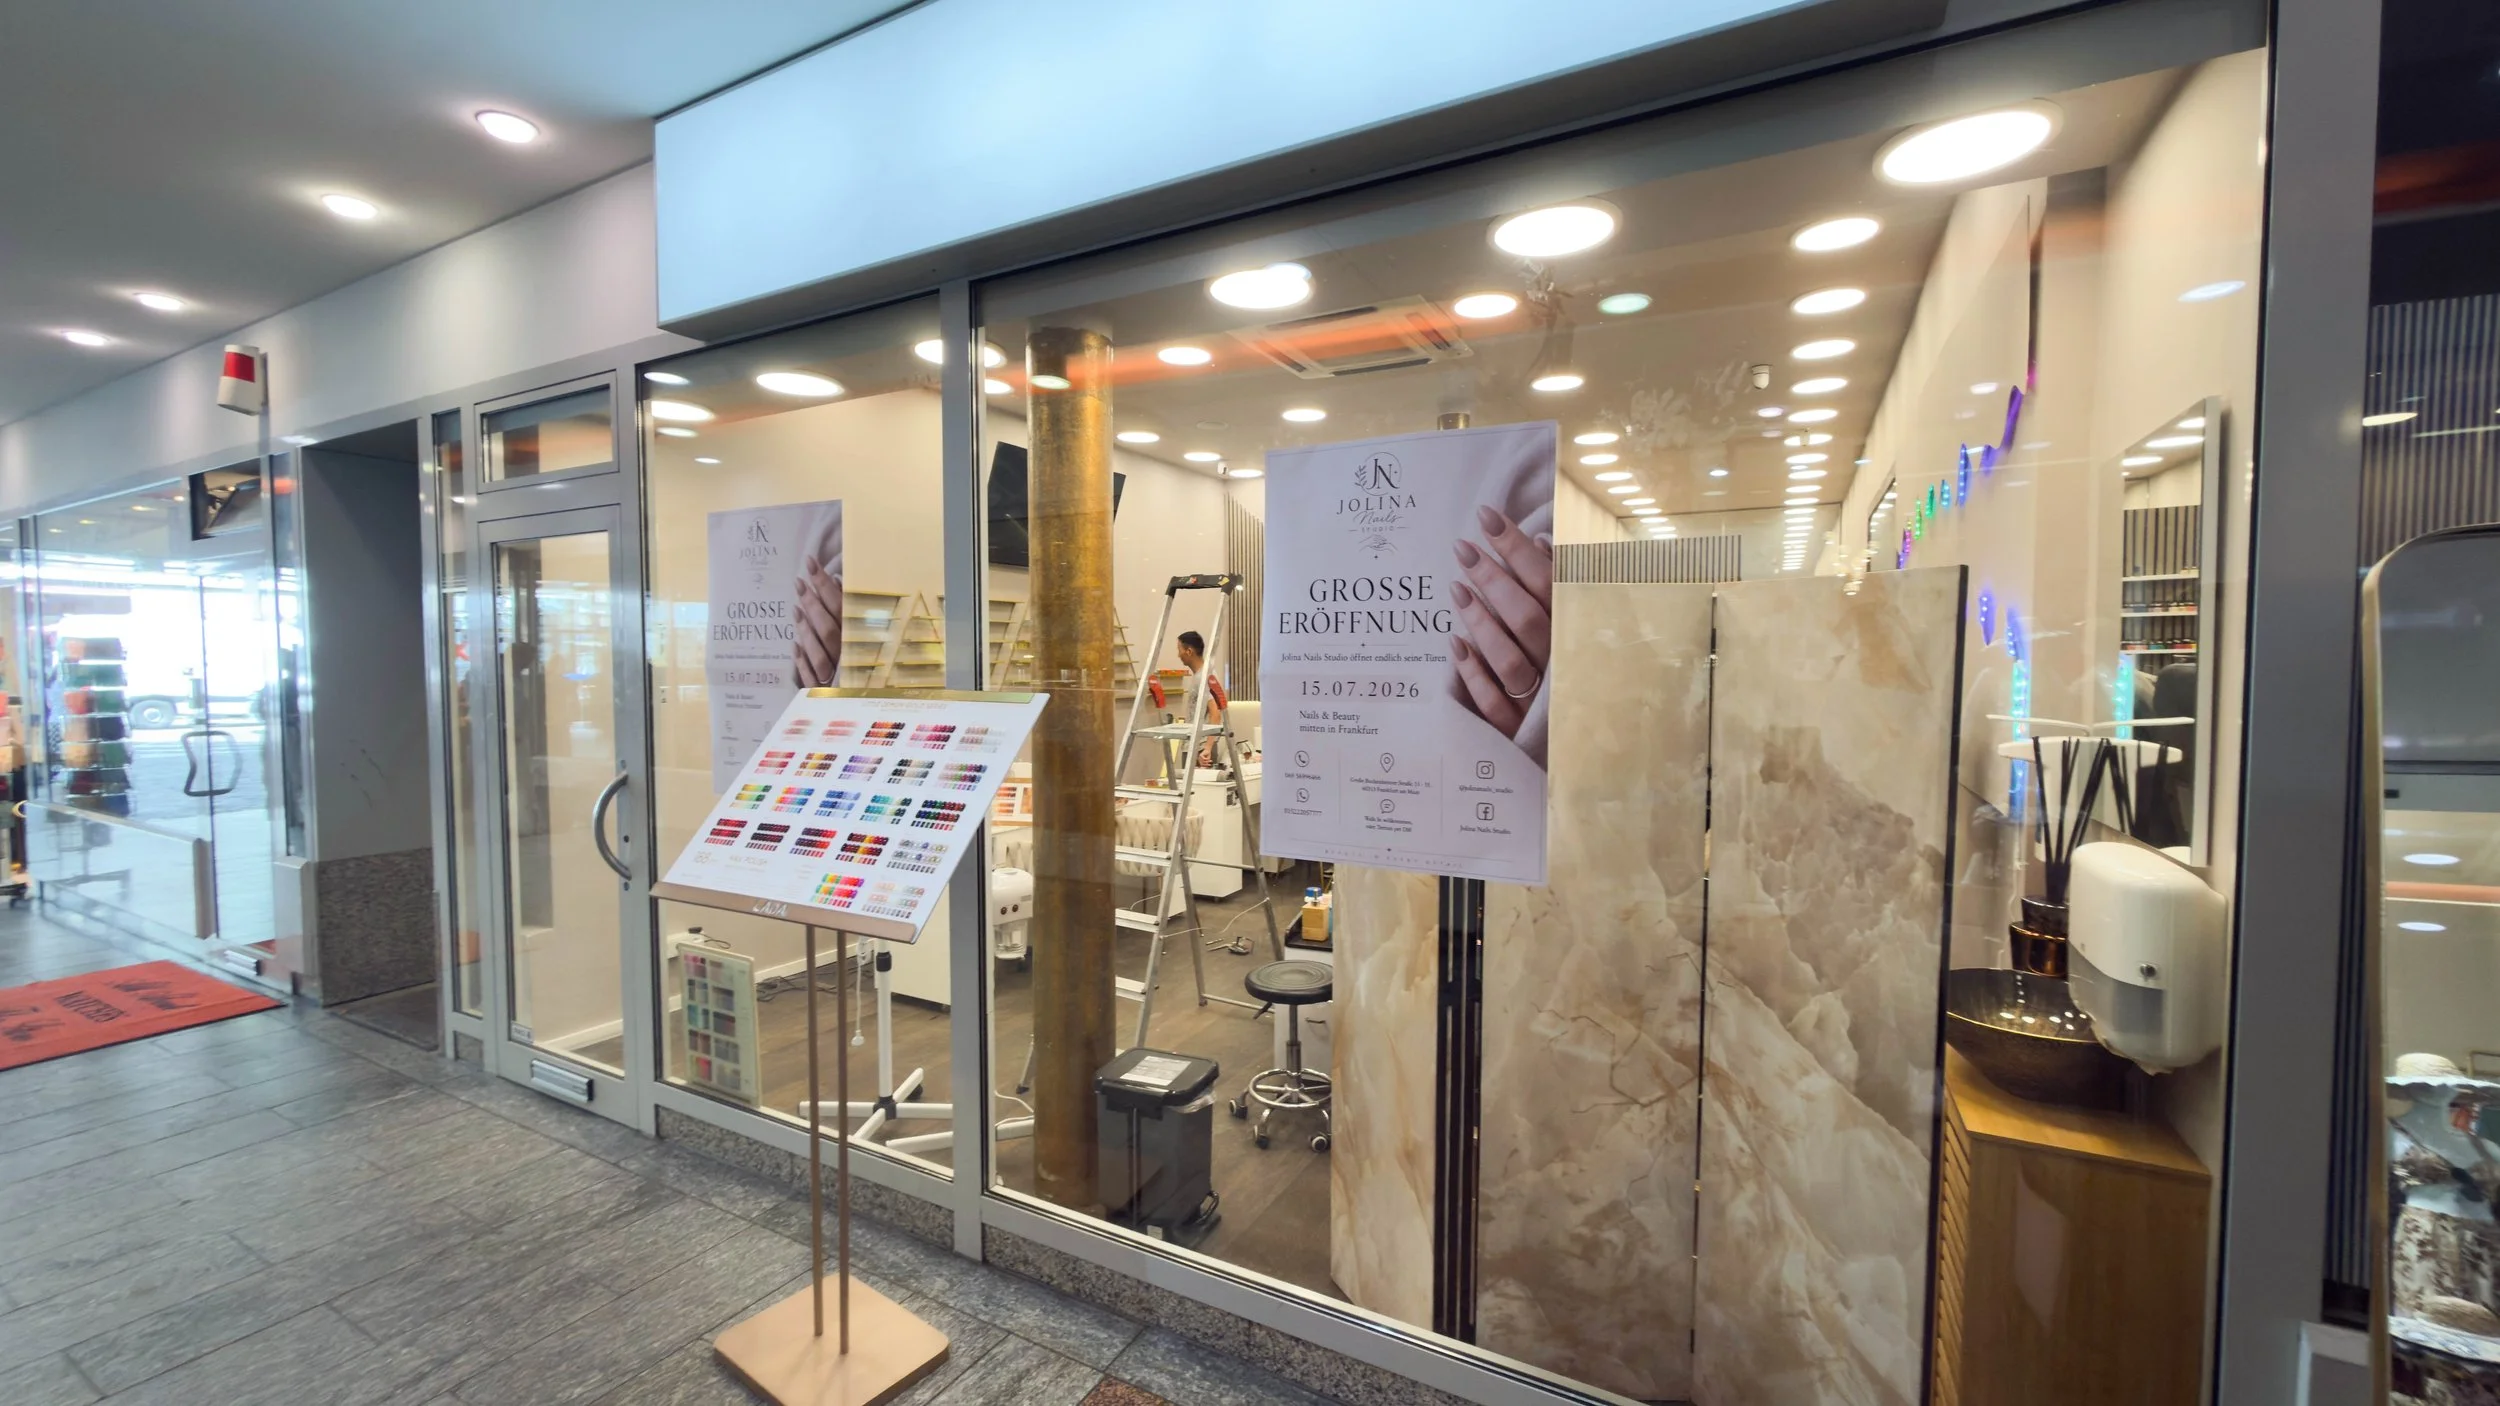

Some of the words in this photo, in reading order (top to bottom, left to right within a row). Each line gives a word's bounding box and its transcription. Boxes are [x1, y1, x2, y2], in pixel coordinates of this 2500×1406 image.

[1336, 495, 1417, 515] JOLINA
[1353, 510, 1404, 524] Nails
[739, 546, 778, 560] JOLINA
[1309, 576, 1434, 603] GROSSE
[727, 600, 786, 619] GROSSE
[1279, 607, 1453, 635] ERÖFFNUNG
[713, 622, 794, 641] ERÖFFNUNG
[1280, 652, 1302, 663] Jolina
[1304, 653, 1322, 662] Nails
[1324, 653, 1348, 662] Studio
[1350, 653, 1372, 662] öffnet
[1374, 653, 1402, 662] endlich
[1404, 654, 1422, 662] seine
[1424, 653, 1447, 662] Türen
[1302, 681, 1420, 698] 15.07.2026
[1300, 711, 1320, 720] Nails
[1322, 711, 1330, 720] &
[1332, 712, 1361, 722] Beauty
[1300, 725, 1326, 734] mitten
[1328, 726, 1336, 734] in
[1338, 725, 1379, 735] Frankfurt
